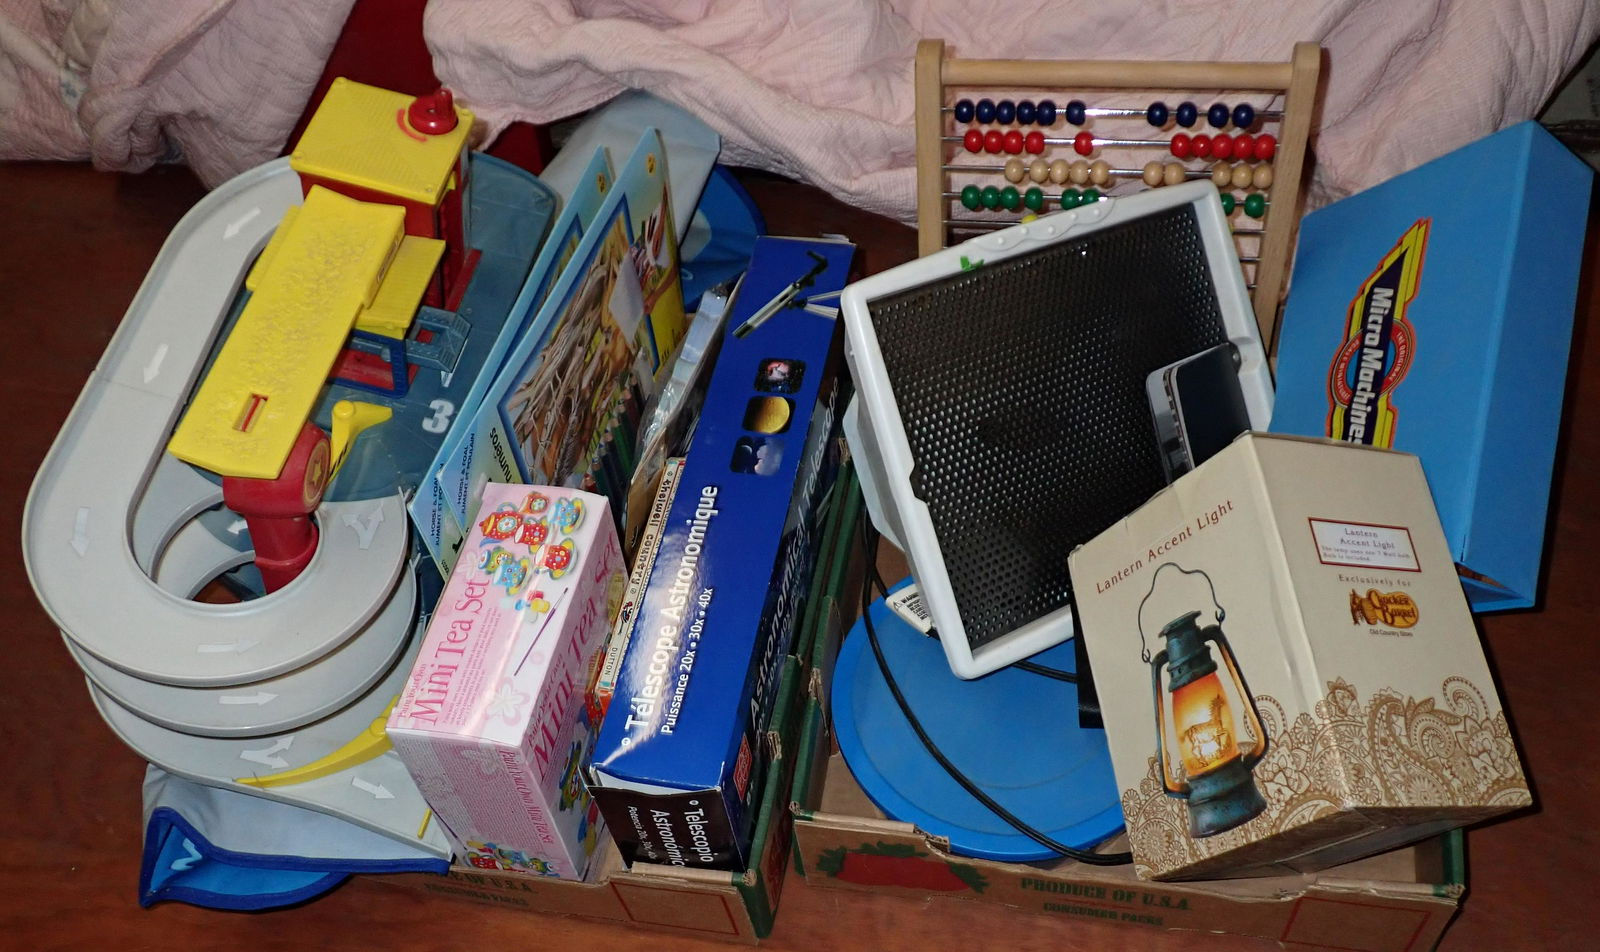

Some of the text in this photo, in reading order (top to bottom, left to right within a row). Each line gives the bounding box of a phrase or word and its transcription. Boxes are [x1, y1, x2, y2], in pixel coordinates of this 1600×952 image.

[1365, 287, 1394, 347] Micro
[422, 400, 454, 433] 3
[456, 477, 465, 505] HORSE
[461, 444, 469, 466] FOAL
[460, 481, 469, 514] JUMENT
[466, 432, 475, 470] POULAIN
[435, 512, 443, 546] JUMENT
[631, 479, 672, 585] thelwell country
[750, 376, 839, 730] Astronomical Telescope
[1096, 499, 1234, 595] Lantern Accent Light
[1340, 538, 1395, 550] Accent Light
[1344, 528, 1379, 538] Lantern
[624, 624, 678, 731] Télescope
[661, 485, 719, 621] Astronomique
[1339, 574, 1393, 586] Exclusively
[410, 663, 458, 726] Mini
[435, 619, 474, 659] Tea
[455, 579, 490, 615] Set
[534, 662, 574, 781] Mini
[568, 598, 597, 664] Tea
[595, 531, 617, 584] Set
[605, 647, 618, 676] DUTTON
[660, 587, 713, 735] Puissance 20x 30x 40x
[499, 750, 518, 770] Paint
[650, 809, 689, 867] Astronómic
[684, 808, 718, 863] Telescopio
[1020, 877, 1106, 899] PRODUCE
[1111, 889, 1138, 903] OF
[1043, 902, 1164, 926] CONSUMER PACKS
